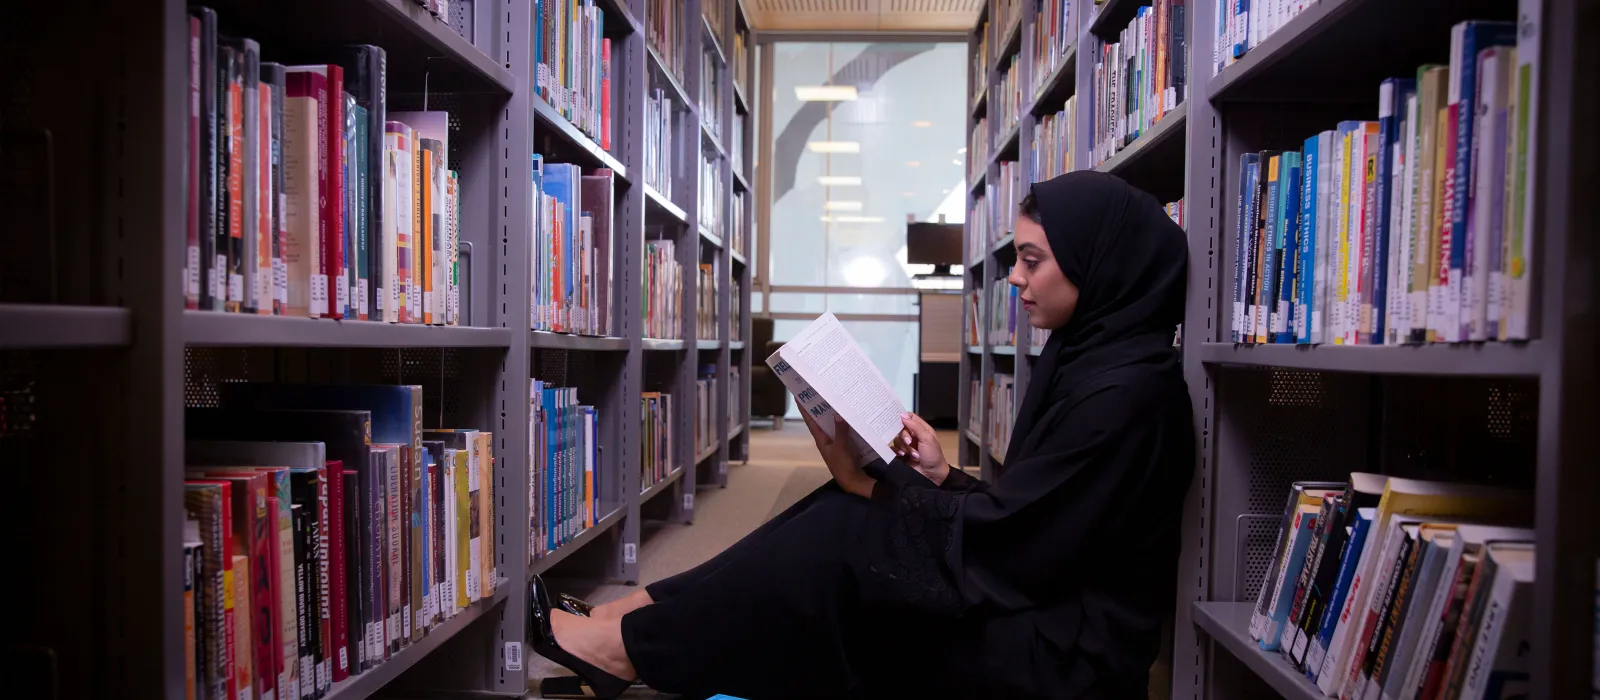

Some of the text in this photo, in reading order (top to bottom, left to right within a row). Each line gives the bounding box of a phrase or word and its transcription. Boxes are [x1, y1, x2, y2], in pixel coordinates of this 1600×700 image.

[1455, 99, 1468, 222] marketing
[1267, 185, 1276, 224] BUSINESS
[1302, 153, 1313, 254] BUSINESS ETHICS
[1363, 188, 1374, 262] Marketing
[1418, 170, 1431, 264] Social Marketing
[1443, 168, 1455, 281] MARKETING
[1265, 225, 1274, 253] ETHICS
[1263, 264, 1271, 292] ACTION
[414, 404, 423, 482] Sudan
[311, 520, 320, 560] JAPAN
[374, 500, 382, 579] CLEOPATRA
[1282, 538, 1293, 573] MARKETING
[1306, 534, 1318, 566] TRUST
[319, 535, 330, 620] Unbound
[1271, 586, 1279, 611] GROWTH
[1299, 542, 1324, 621] SENSORY MARKETING
[1385, 559, 1402, 606] COMPLETE
[299, 616, 307, 648] ODYSSEY
[1370, 606, 1386, 652] MARKETER
[1372, 625, 1393, 681] MARKETIN
